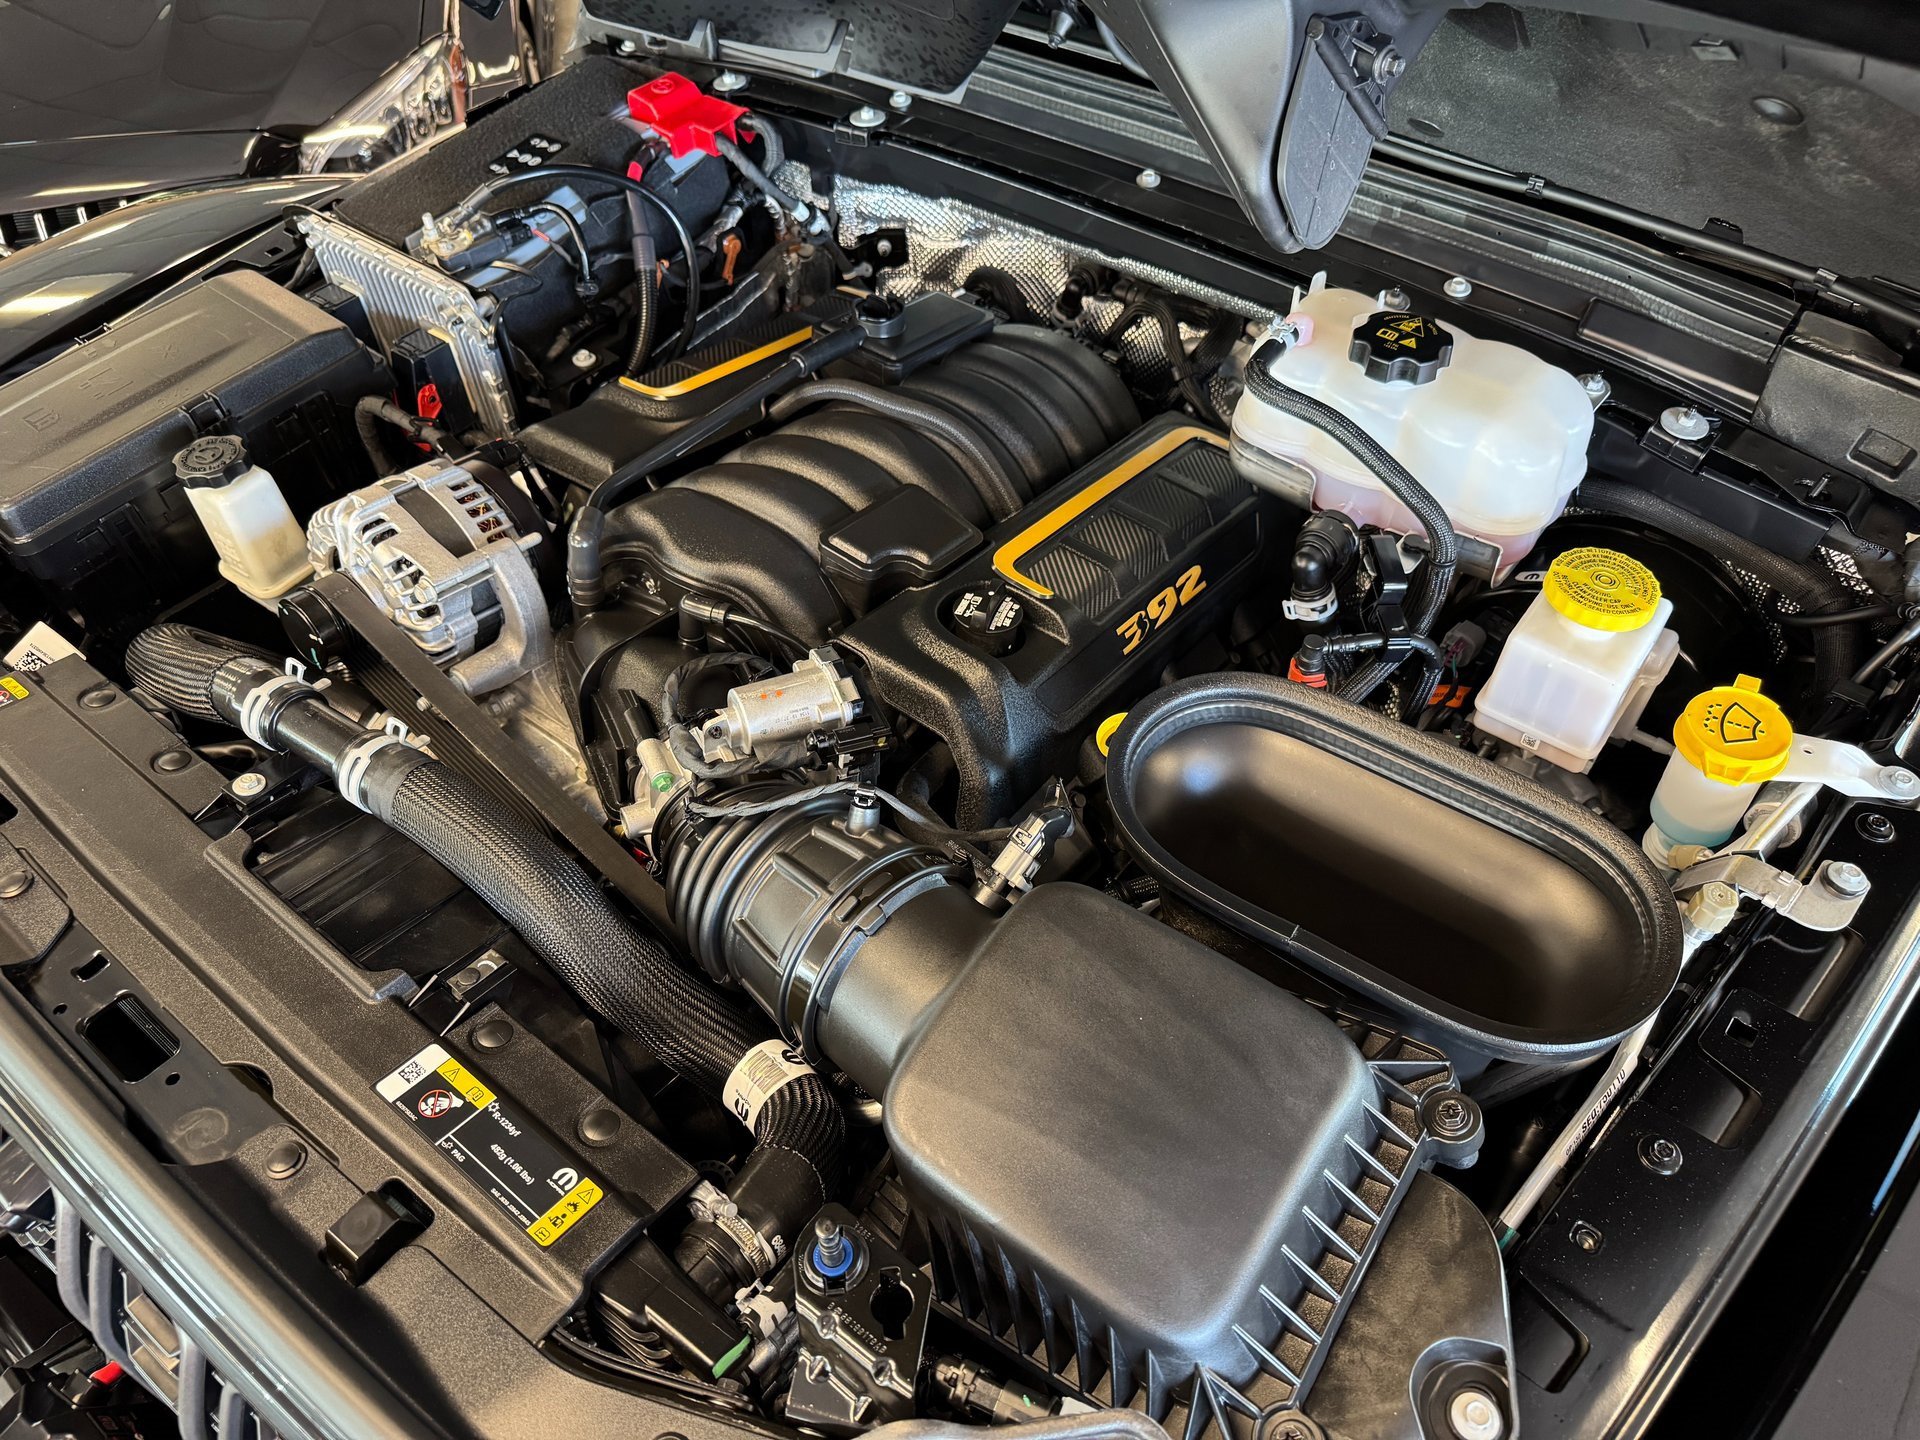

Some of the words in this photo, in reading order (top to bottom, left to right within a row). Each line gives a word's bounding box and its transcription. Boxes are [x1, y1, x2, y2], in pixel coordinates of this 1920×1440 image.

[1115, 565, 1207, 655] 392
[492, 1111, 522, 1138] R-1234yf
[451, 1148, 466, 1163] PAG
[490, 1143, 506, 1162] 482g
[504, 1156, 521, 1175] (1.06
[519, 1168, 535, 1185] lbs)
